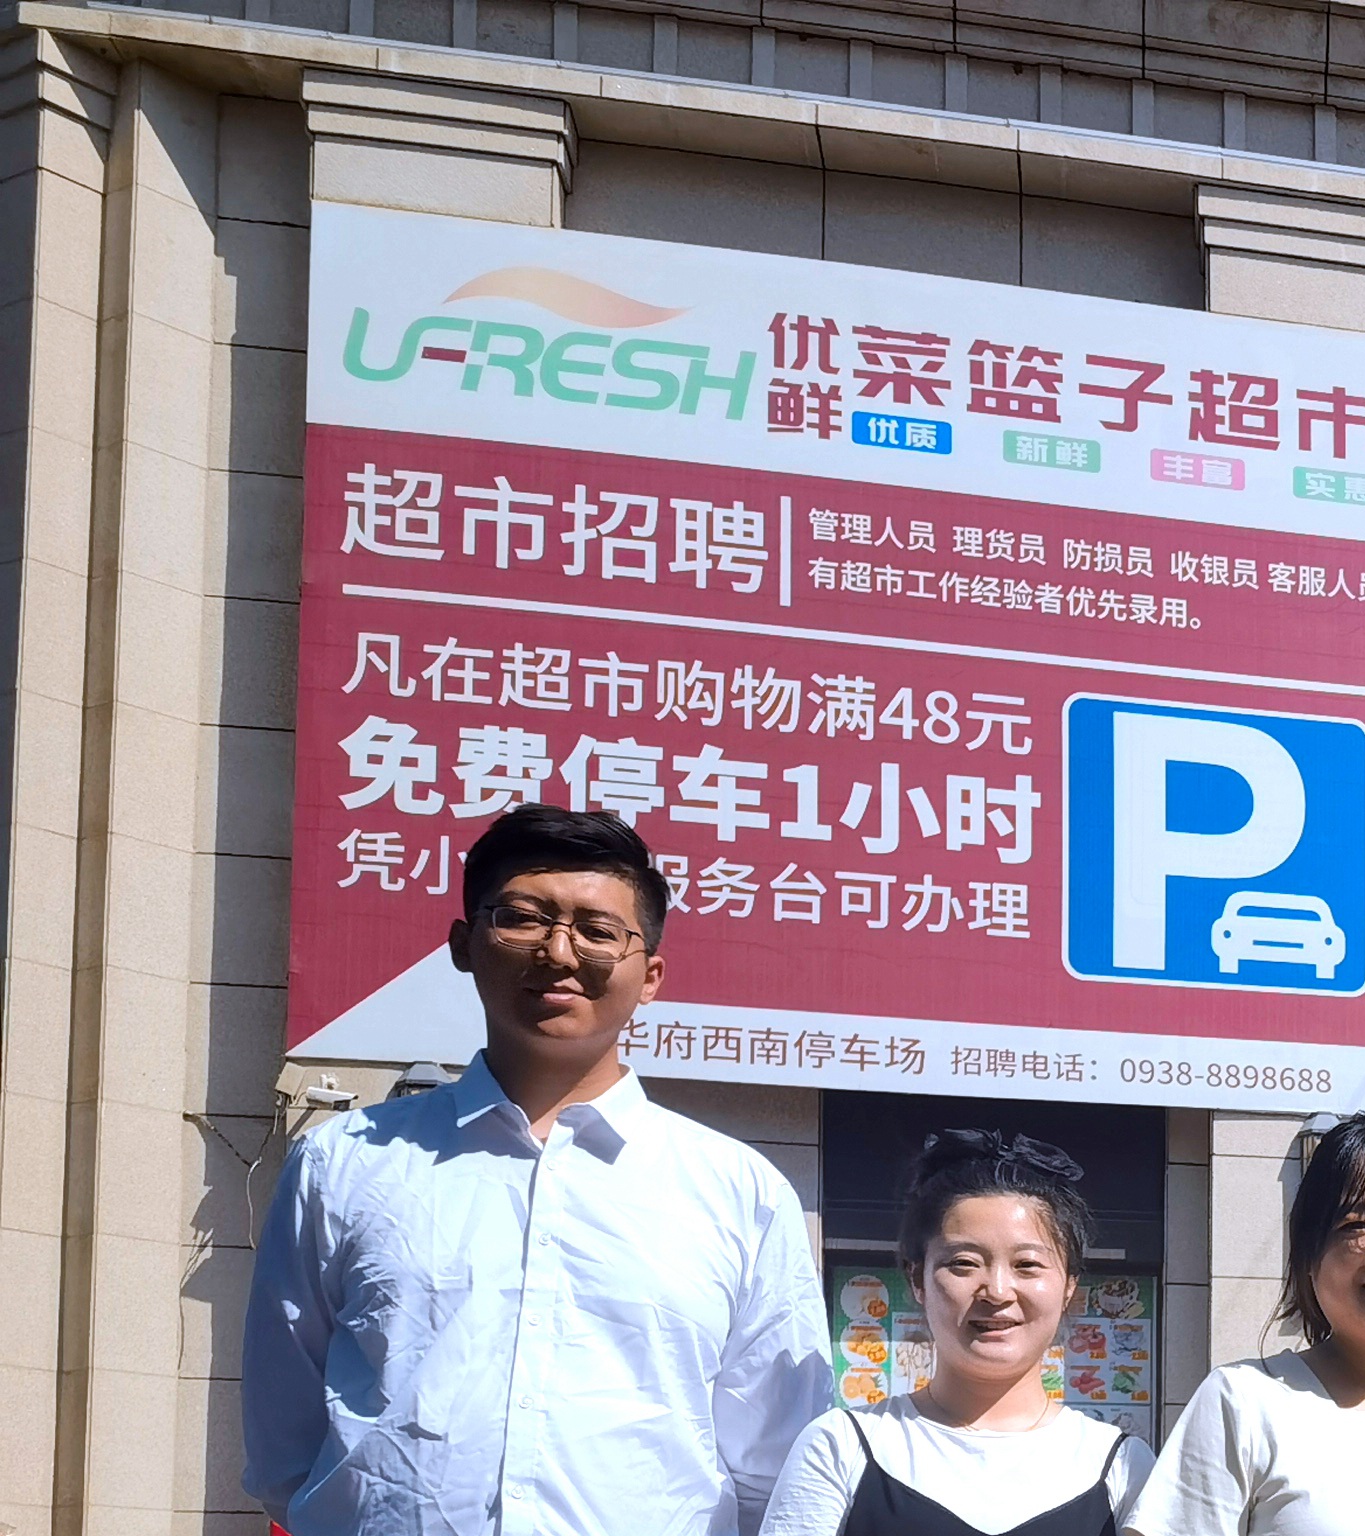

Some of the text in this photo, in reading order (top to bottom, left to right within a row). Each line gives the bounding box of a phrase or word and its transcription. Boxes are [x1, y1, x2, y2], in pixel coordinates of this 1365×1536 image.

[867, 417, 938, 450] 优质
[1015, 436, 1088, 467] 新鲜
[340, 463, 769, 593] 超市招聘
[808, 508, 936, 555] 管理人员
[952, 525, 1046, 567] 理货员
[1062, 538, 1153, 580] 防损员
[1170, 550, 1259, 592] 收银员
[808, 557, 1201, 631] 有超市工作经验者优先录用。
[342, 632, 1033, 756] 凡在超市购物满48元
[337, 714, 1041, 866] 免费停车1小时
